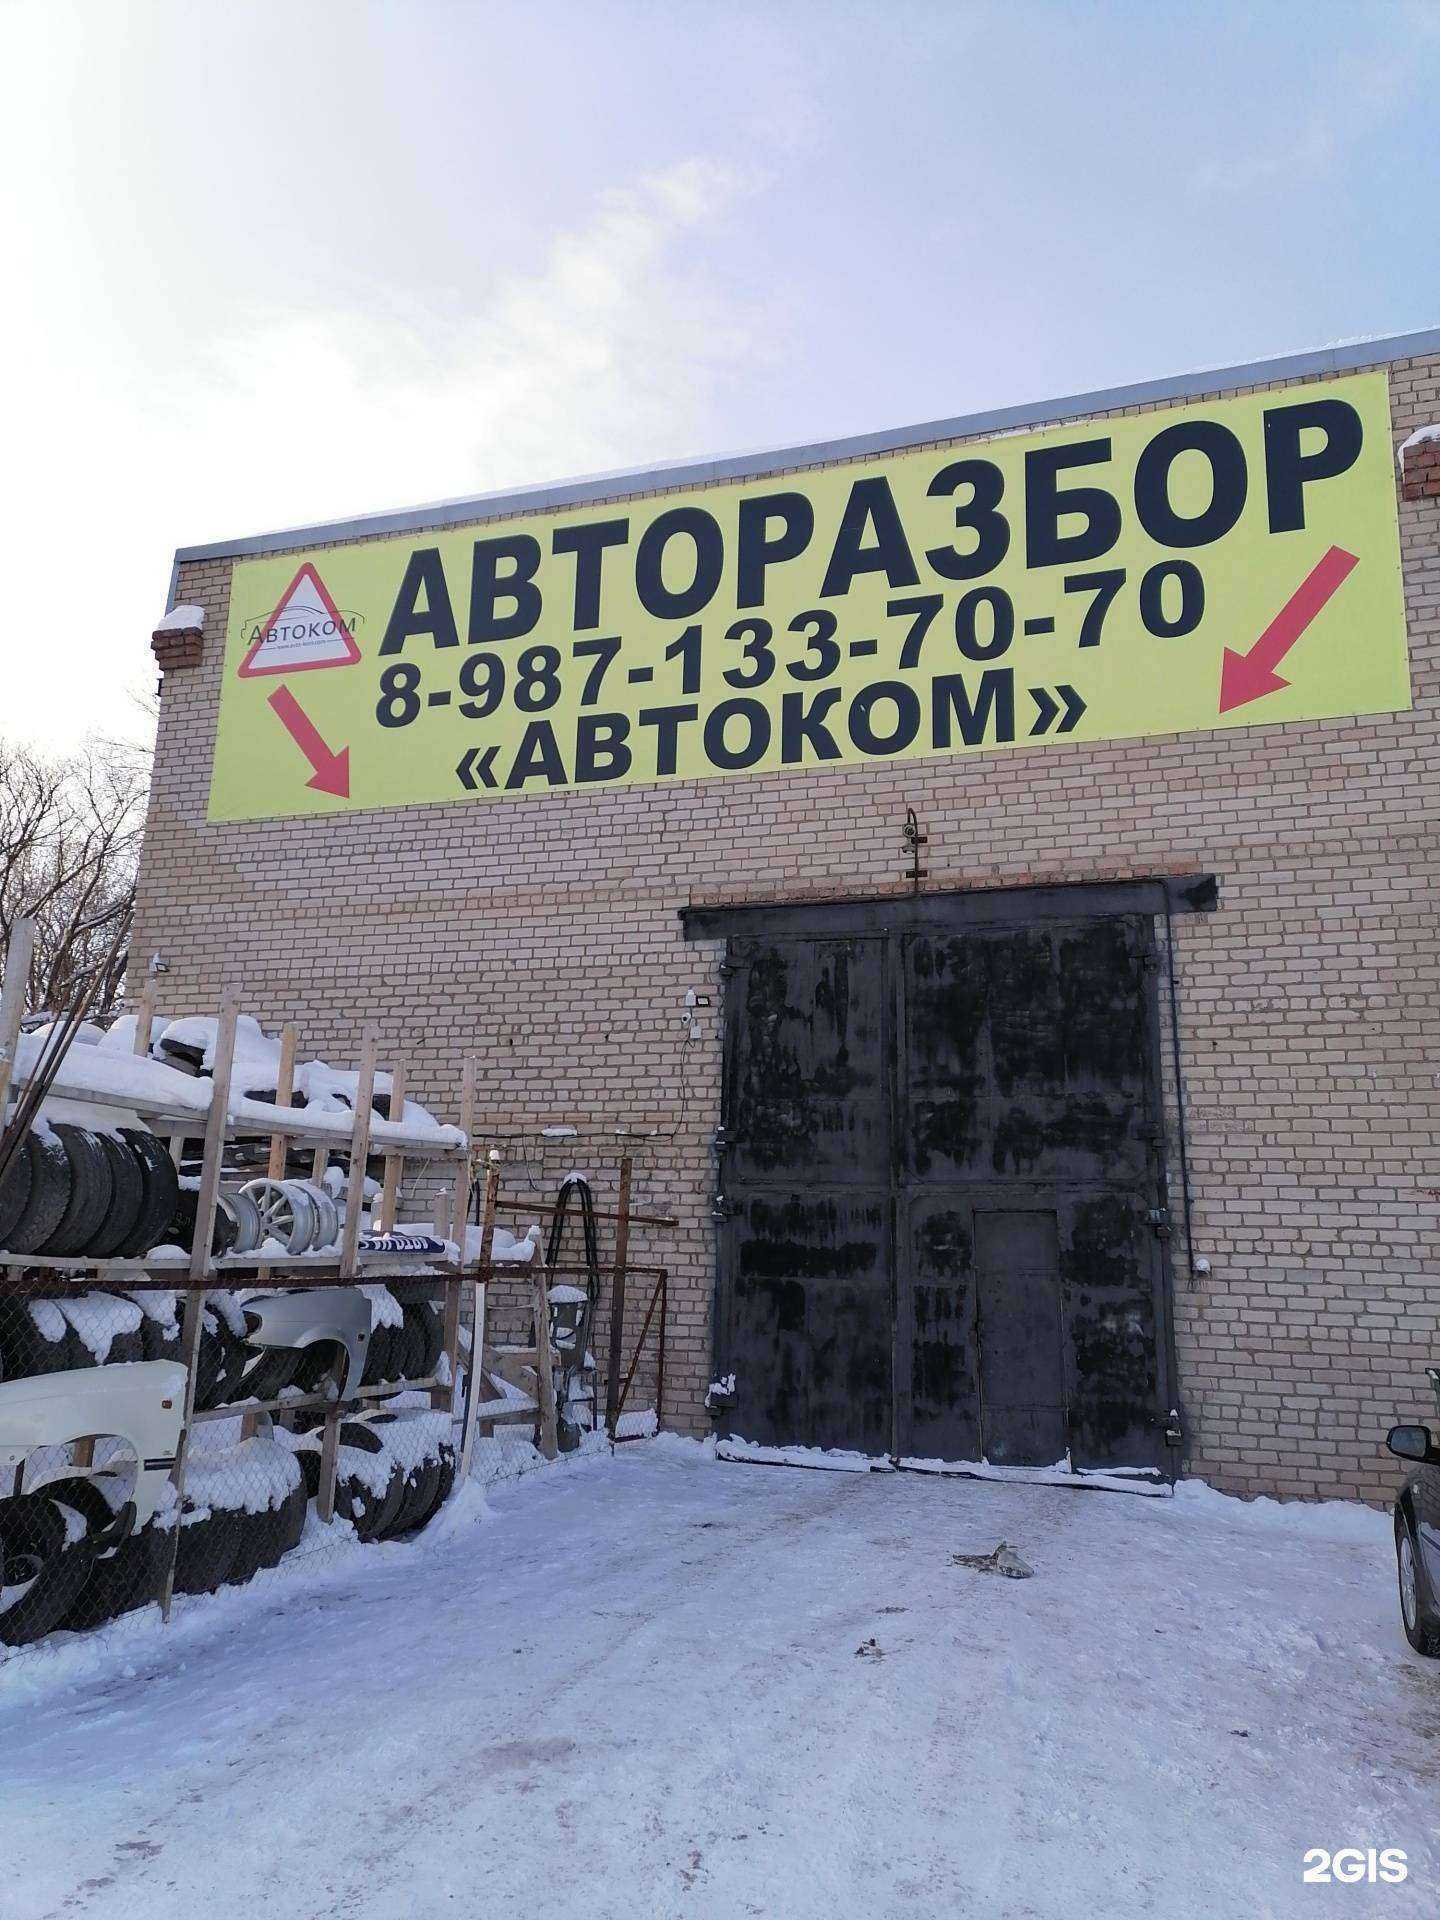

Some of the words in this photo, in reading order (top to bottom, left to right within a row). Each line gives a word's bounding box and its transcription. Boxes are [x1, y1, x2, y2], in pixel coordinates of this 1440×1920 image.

[378, 400, 1364, 656] АВТОРАЗБОР
[247, 617, 357, 646] АВТОКОМ
[375, 559, 1205, 728] 8-987-133-70-70
[455, 667, 1088, 791] «АВТОКОМ»
